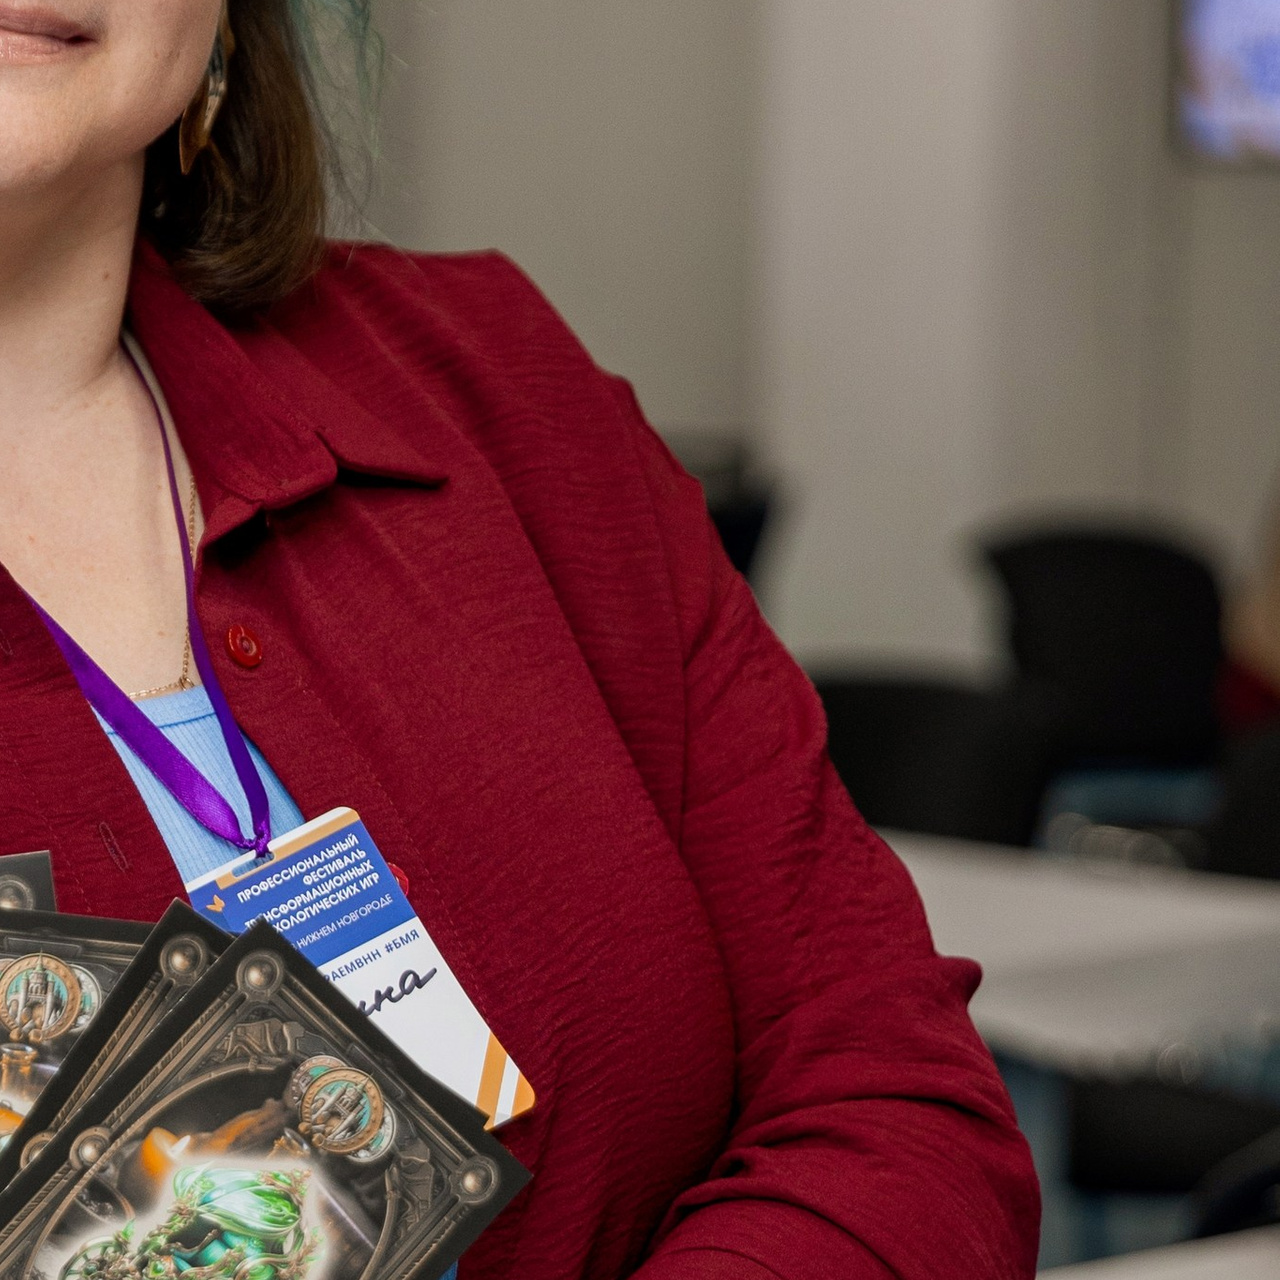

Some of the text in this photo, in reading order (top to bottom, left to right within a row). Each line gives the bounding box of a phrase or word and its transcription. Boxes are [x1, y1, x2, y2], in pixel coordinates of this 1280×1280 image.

[237, 833, 360, 903] ПРОФЕССИОНАЛЬНЫЙ
[244, 860, 375, 930] ТРНСФОРМАЦИОННЫХ
[303, 848, 367, 886] ФЕСТИВАЛЬ
[273, 872, 380, 933] ХОЛОГИЧЕСКИХ ИГР
[296, 893, 394, 950] НИЖНЕМ НОВГОРОДЕ
[324, 929, 420, 983] РАЕМВНН #БМЯ
